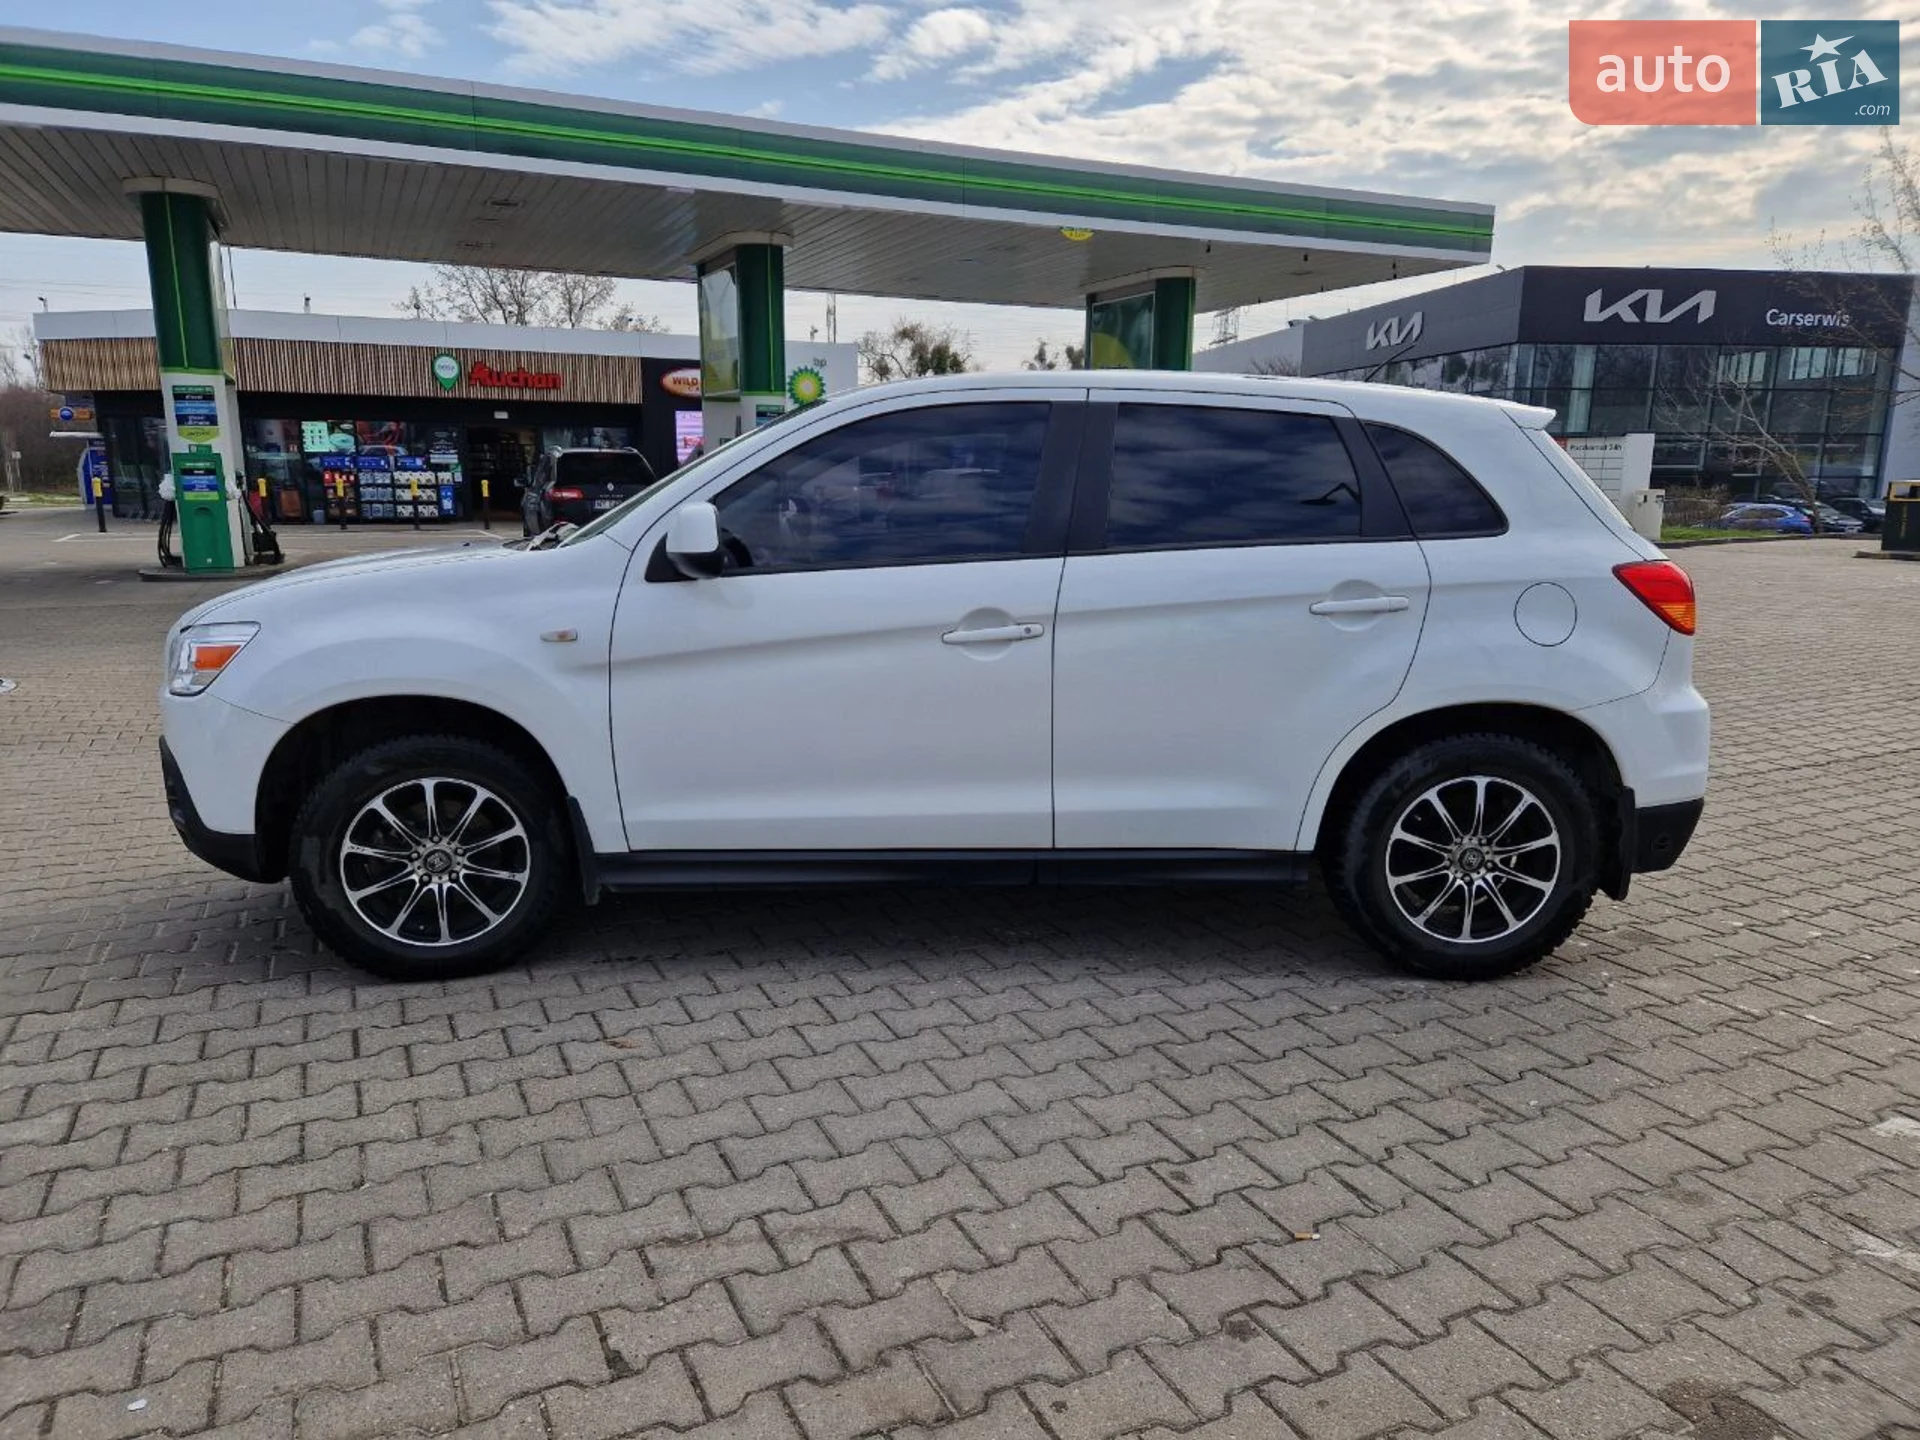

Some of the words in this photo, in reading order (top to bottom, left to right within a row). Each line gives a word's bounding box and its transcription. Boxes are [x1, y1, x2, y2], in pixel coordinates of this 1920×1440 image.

[1584, 288, 1717, 324] KIA
[1766, 307, 1850, 328] Carserwis
[1366, 311, 1424, 351] KIA
[469, 360, 563, 389] Auchan
[672, 376, 699, 386] WILD
